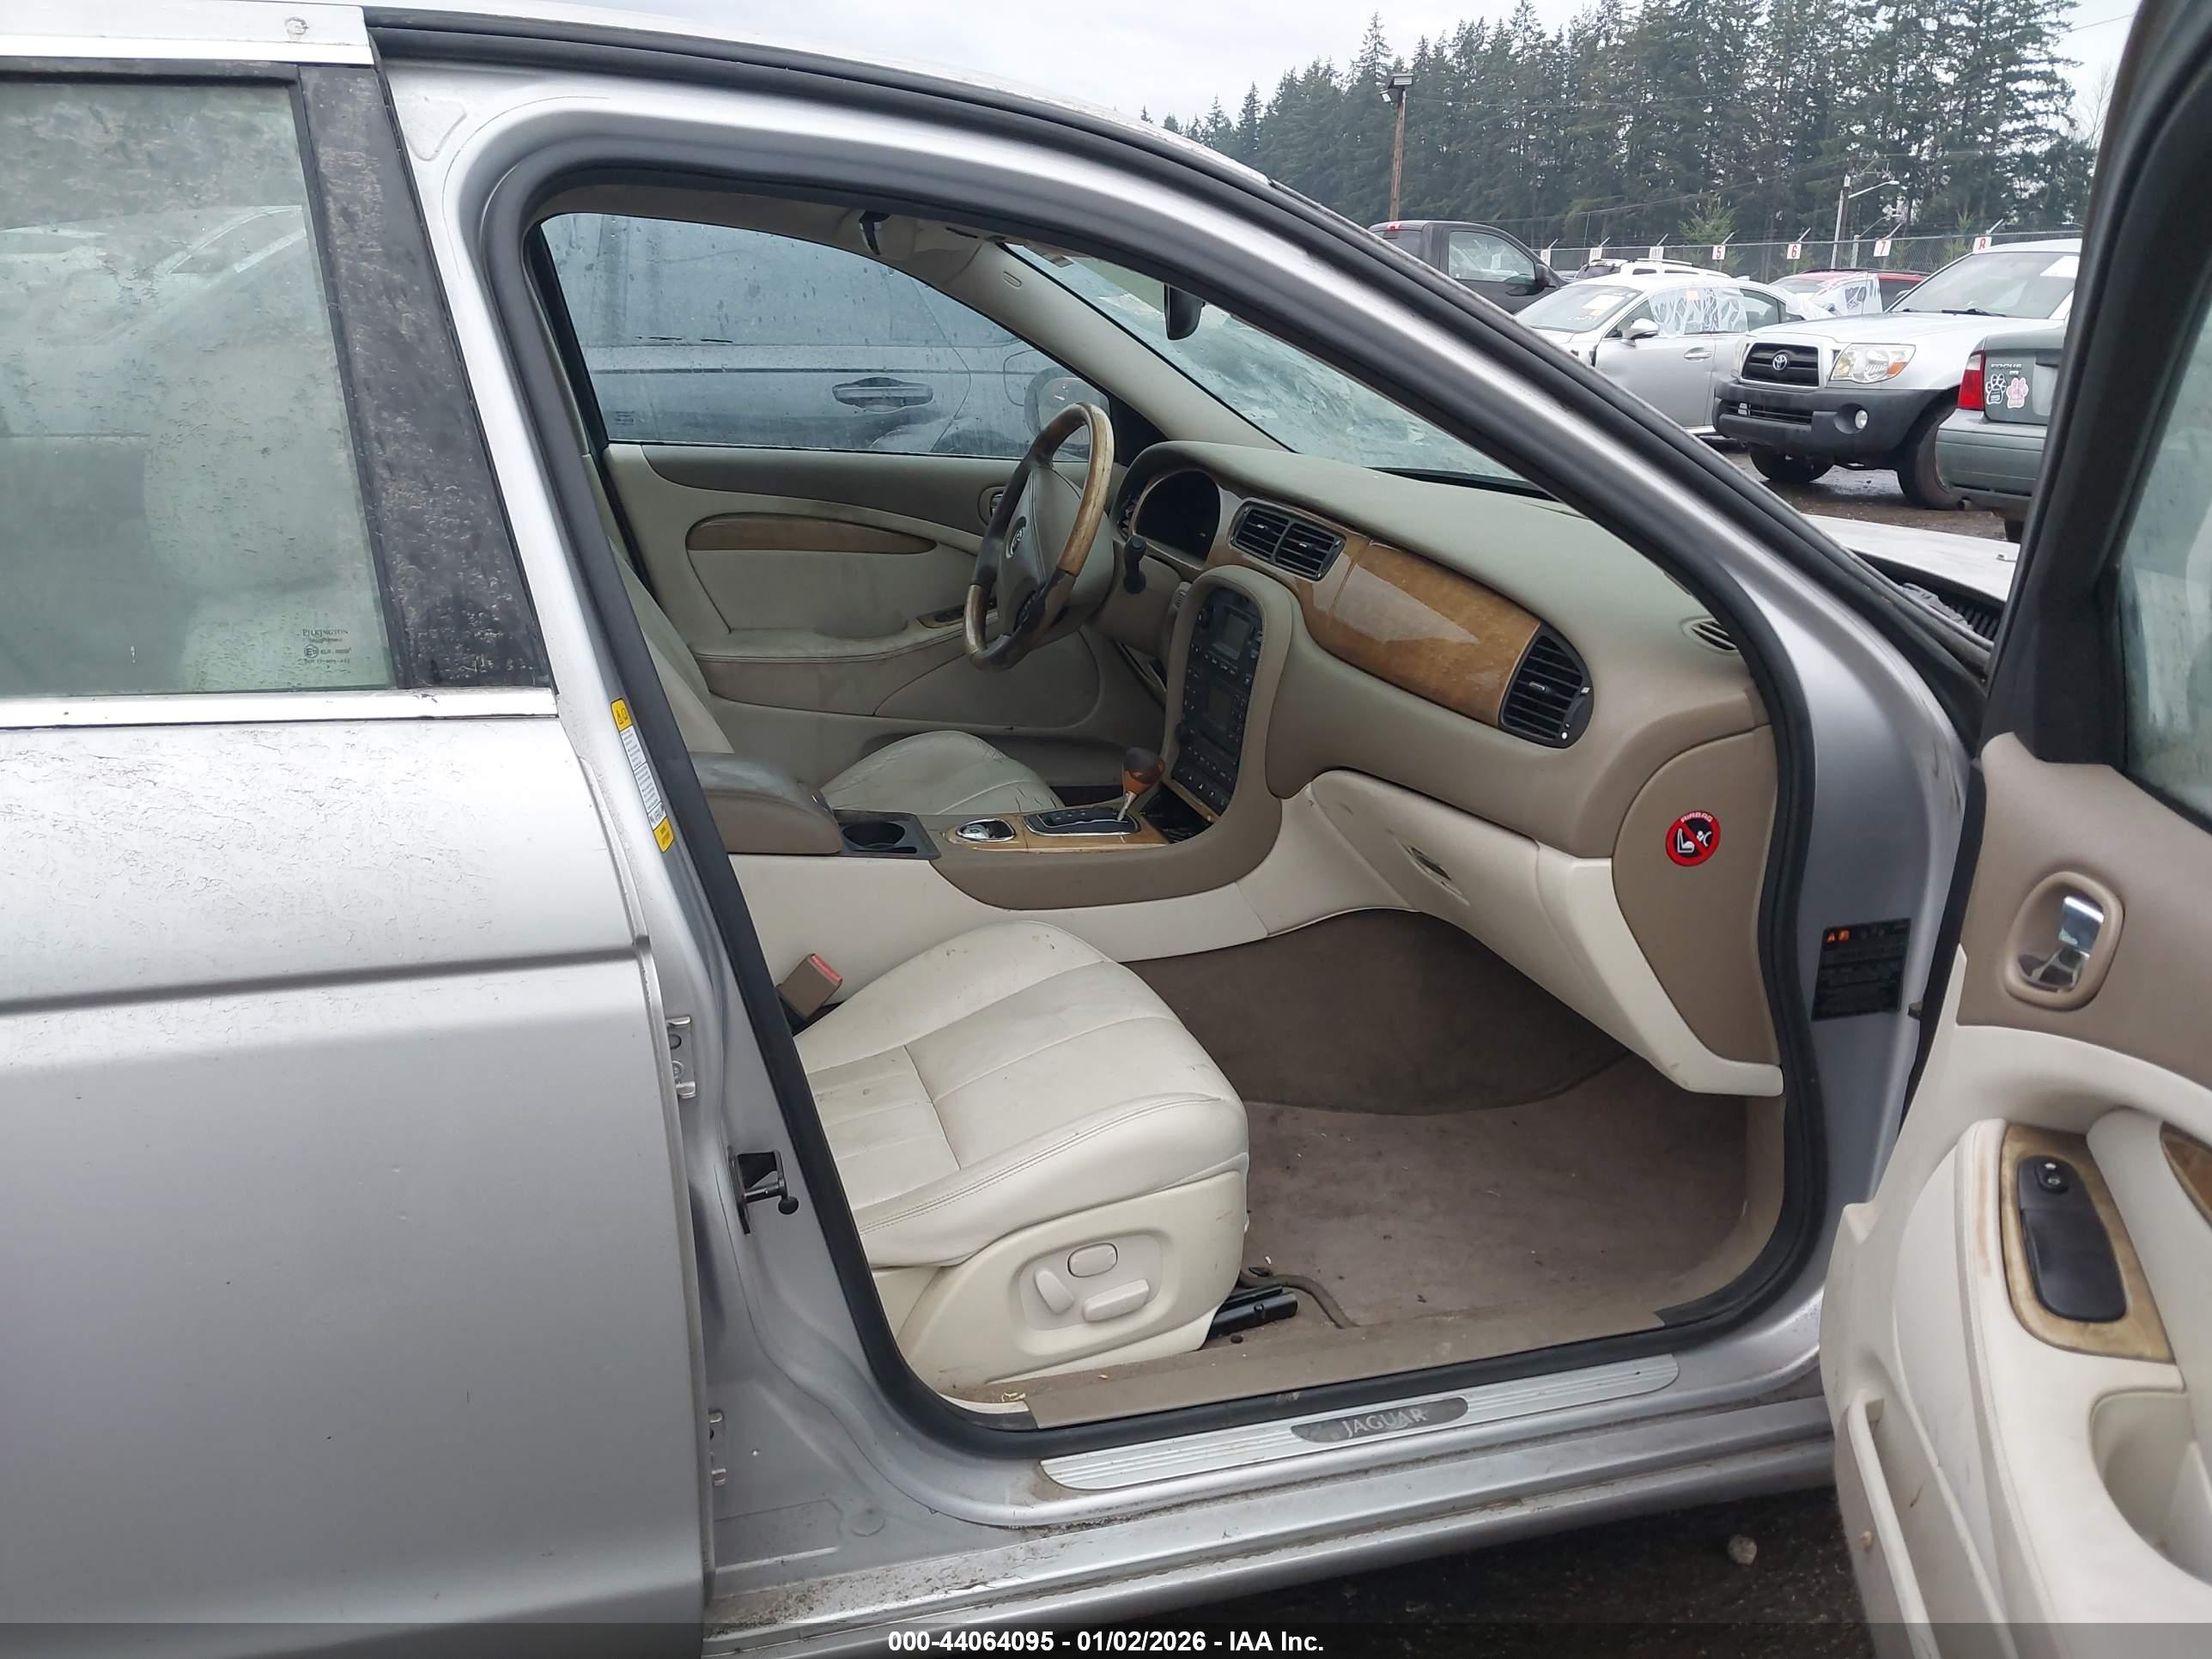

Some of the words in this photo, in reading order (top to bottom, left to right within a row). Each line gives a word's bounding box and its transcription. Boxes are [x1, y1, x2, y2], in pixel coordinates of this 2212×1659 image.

[1716, 246, 1722, 259] 5
[1791, 245, 1797, 258] 6
[1880, 241, 1887, 256] 7
[1680, 811, 1713, 823] AIRBAG
[1341, 1408, 1427, 1437] JAGUAR
